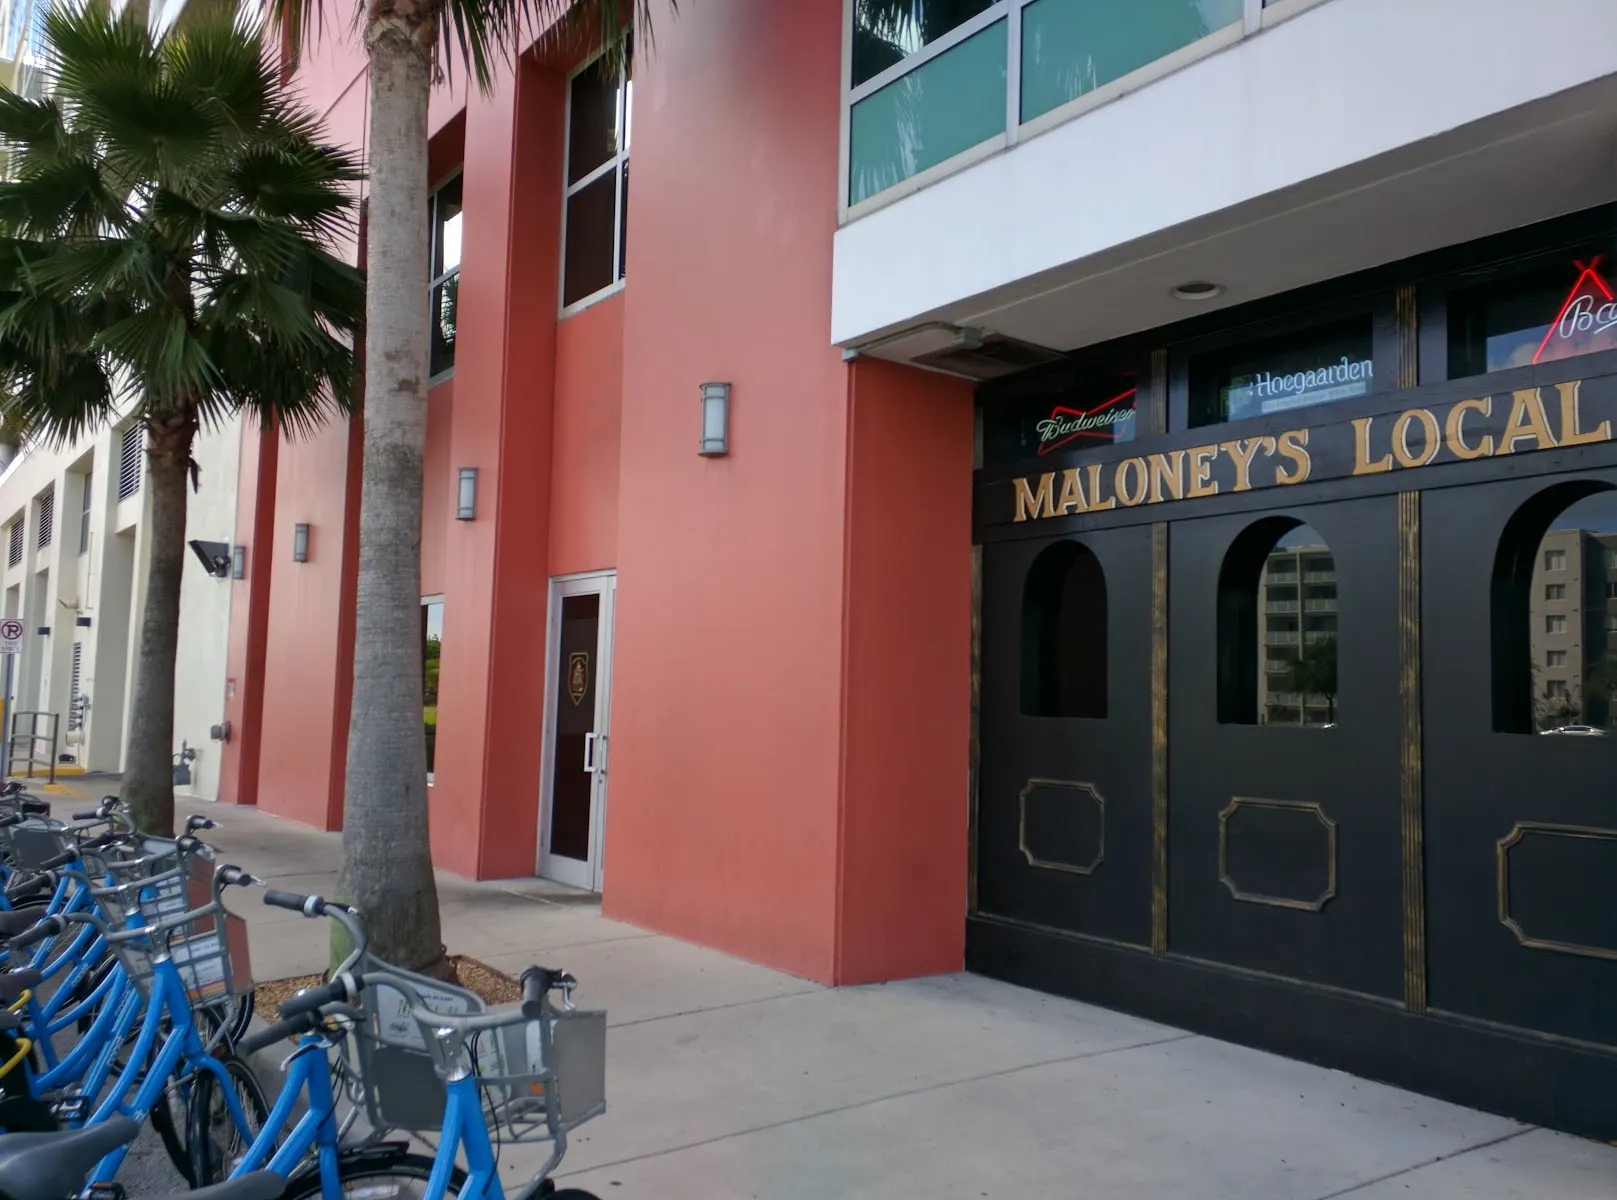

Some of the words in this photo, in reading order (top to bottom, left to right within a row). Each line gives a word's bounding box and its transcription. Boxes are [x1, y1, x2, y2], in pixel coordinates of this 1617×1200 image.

[1256, 356, 1373, 396] Hoegaarden
[1036, 408, 1136, 442] Budweiser
[1012, 428, 1311, 522] MALONEY'S
[1351, 380, 1612, 476] LOCAL
